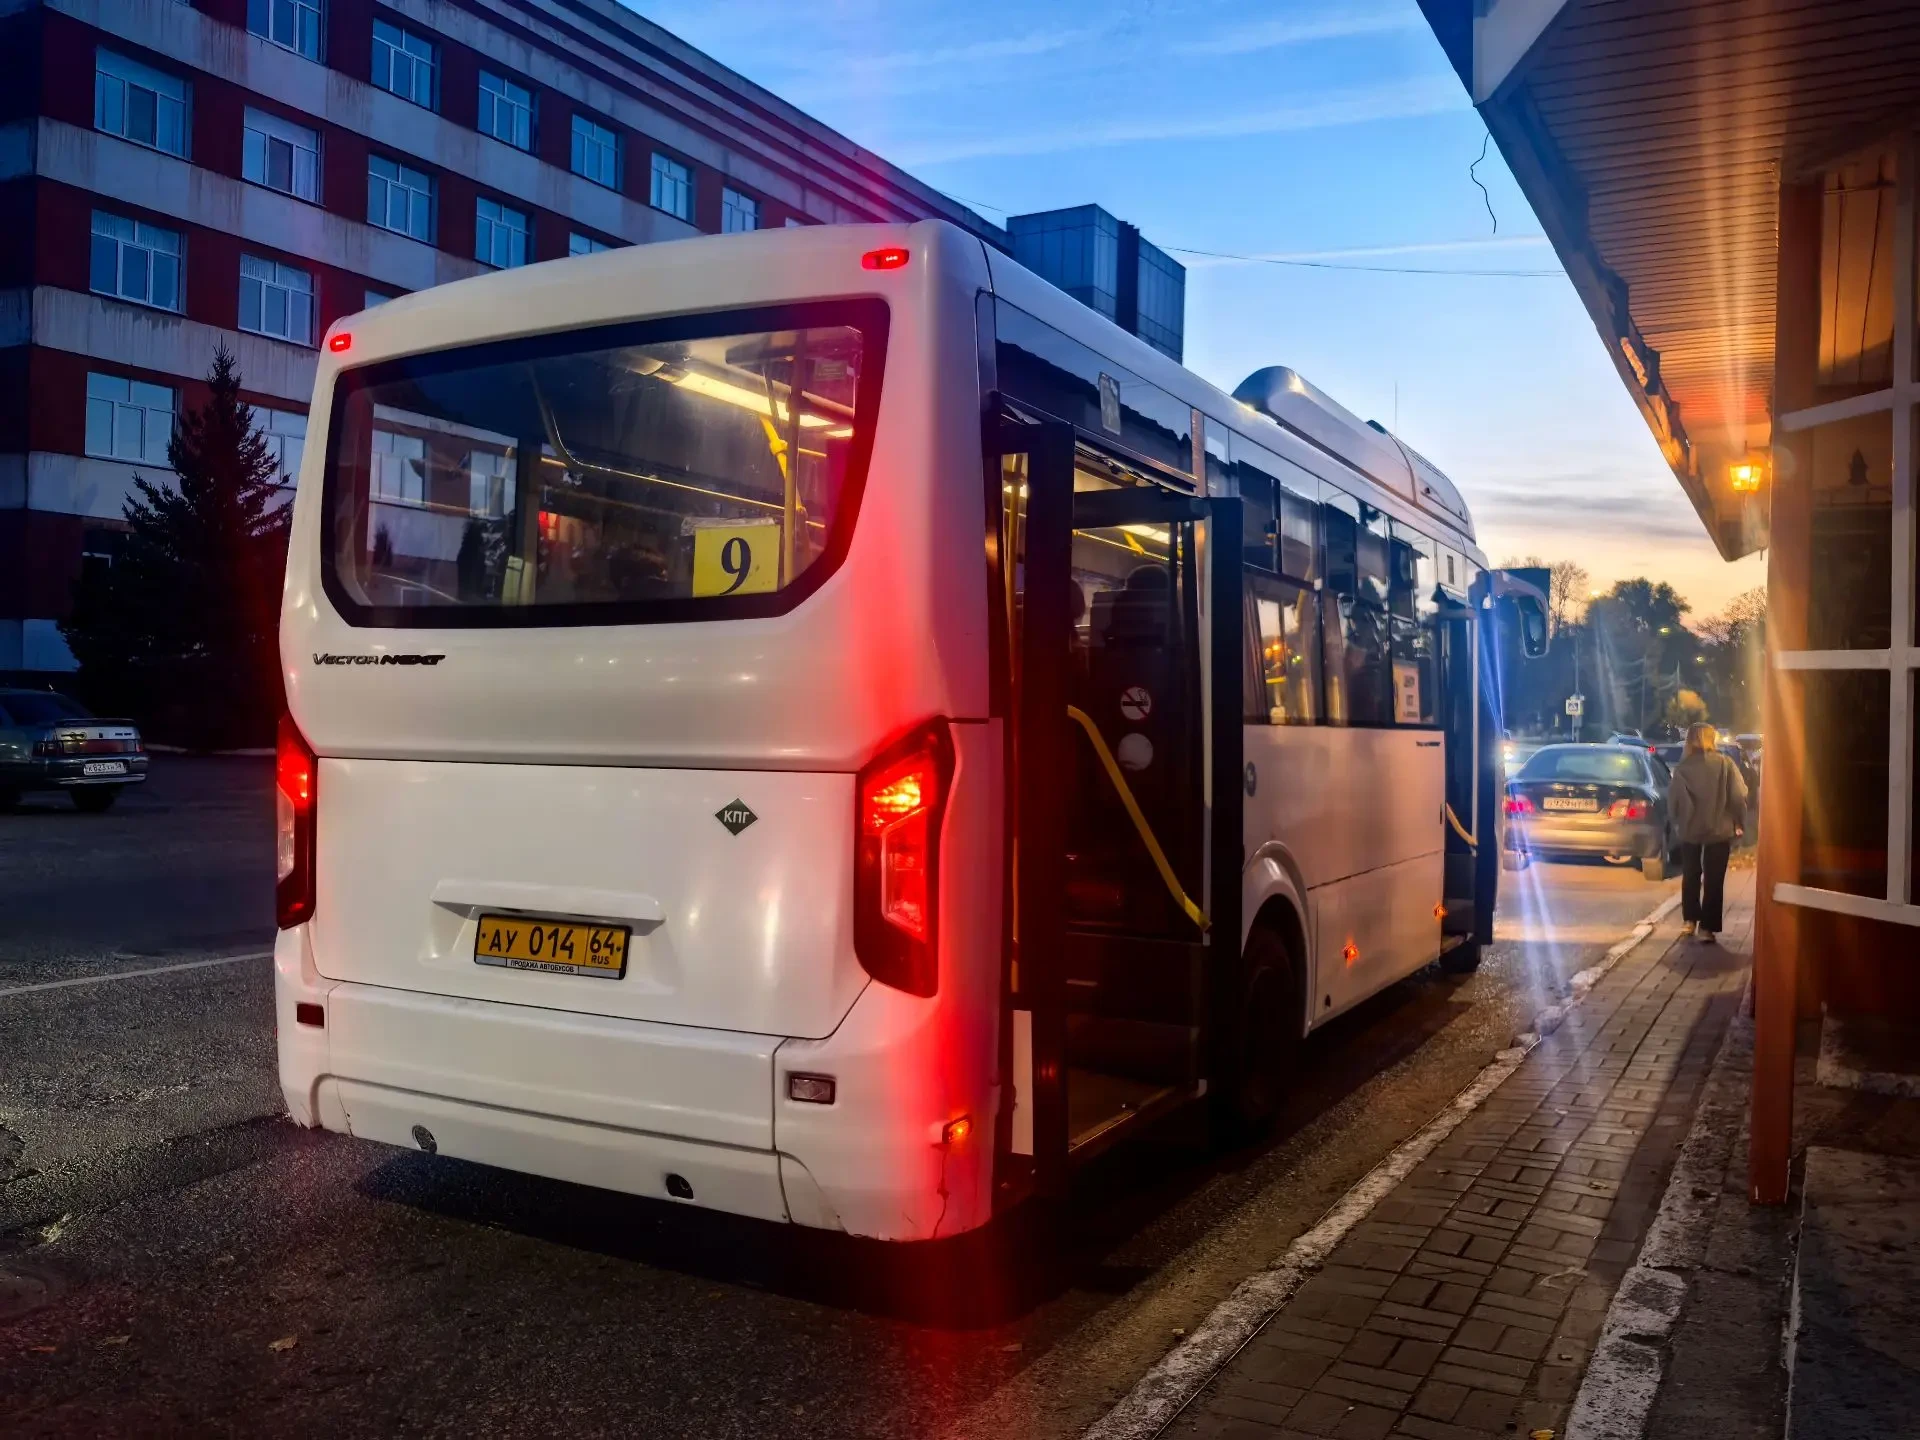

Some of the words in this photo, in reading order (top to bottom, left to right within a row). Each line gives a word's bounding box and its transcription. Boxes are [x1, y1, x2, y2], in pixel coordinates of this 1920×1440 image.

[719, 537, 752, 596] 9
[724, 810, 750, 824] КПГ
[489, 929, 518, 953] АУ
[528, 926, 574, 959] 014
[589, 929, 614, 957] 64
[510, 959, 539, 969] ПРОДАЖА
[539, 962, 575, 973] АВТОБУСОВ
[591, 955, 610, 965] RUS
